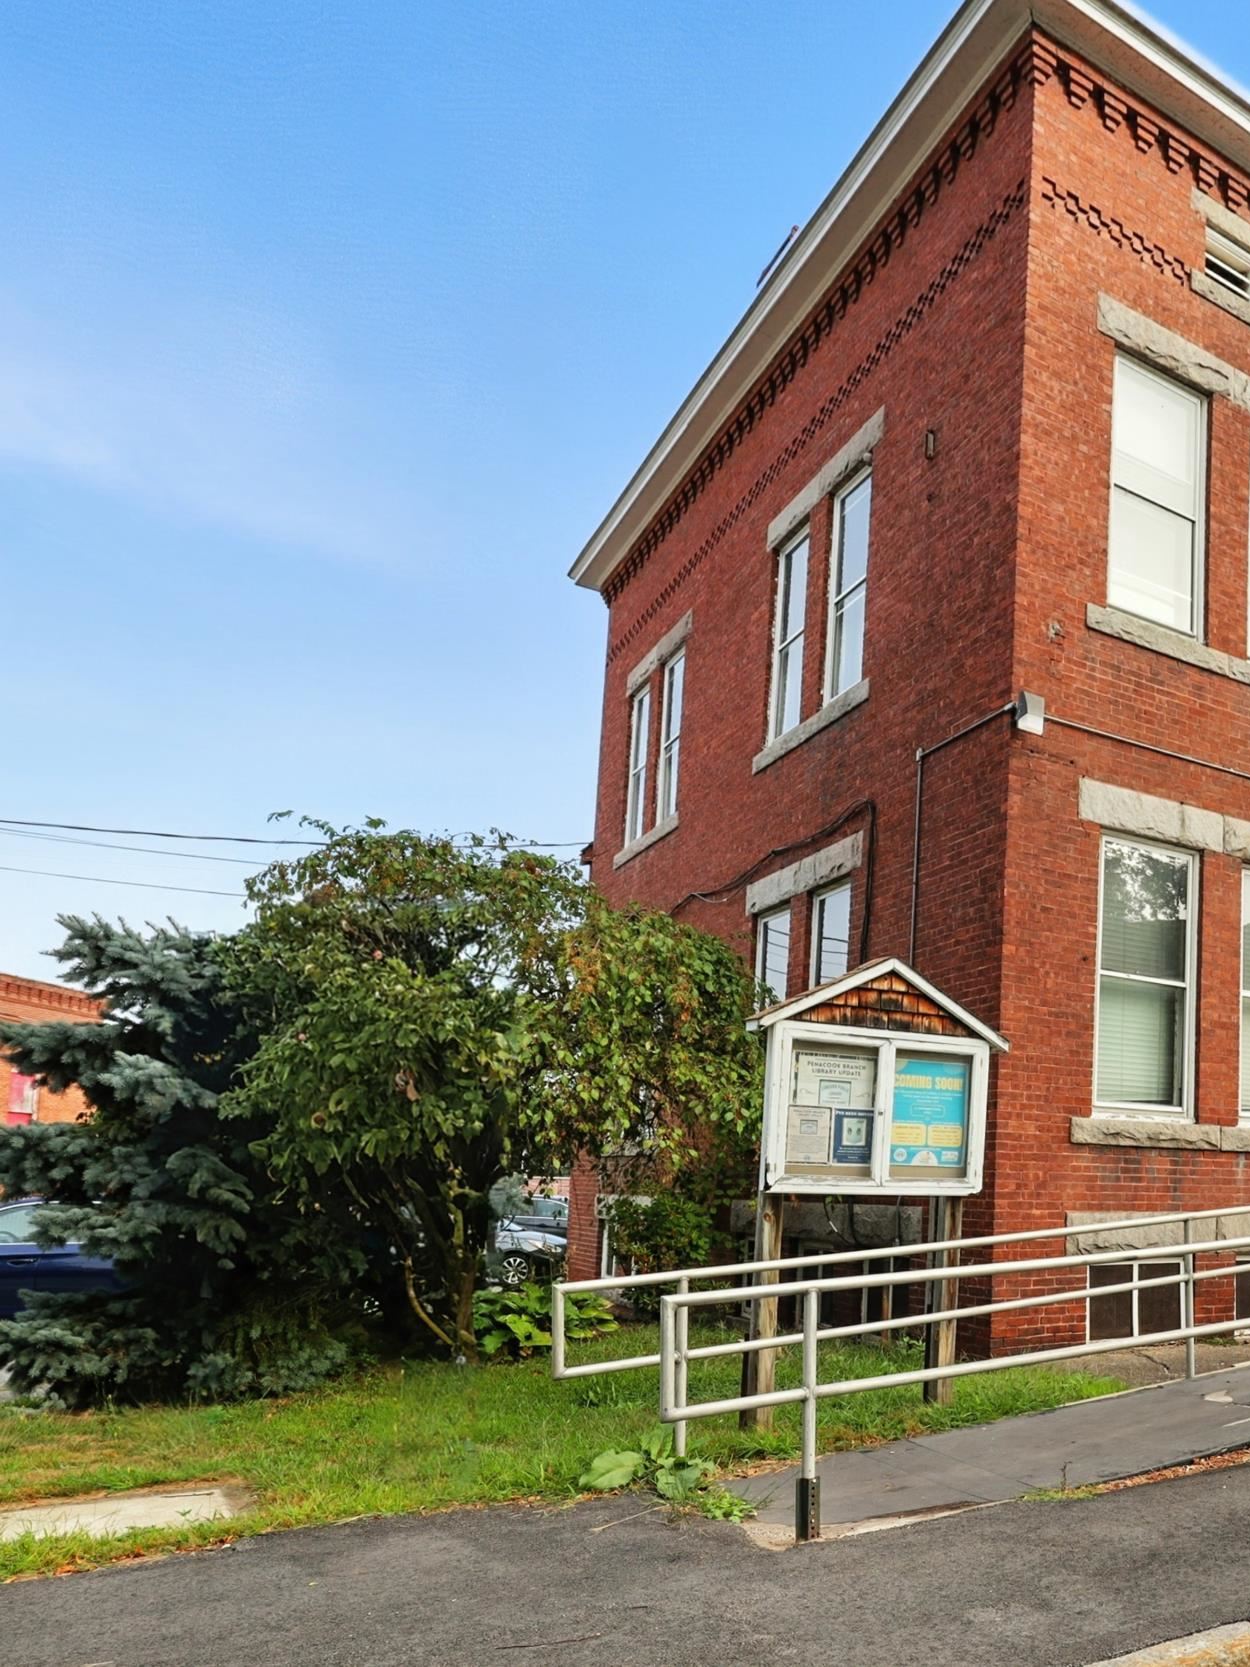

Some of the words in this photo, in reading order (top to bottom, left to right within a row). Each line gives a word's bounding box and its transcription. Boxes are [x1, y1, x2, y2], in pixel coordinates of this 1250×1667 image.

[807, 1060, 841, 1069] PENACOOK
[843, 1063, 867, 1071] BRANCH
[838, 1069, 862, 1077] UPDATE
